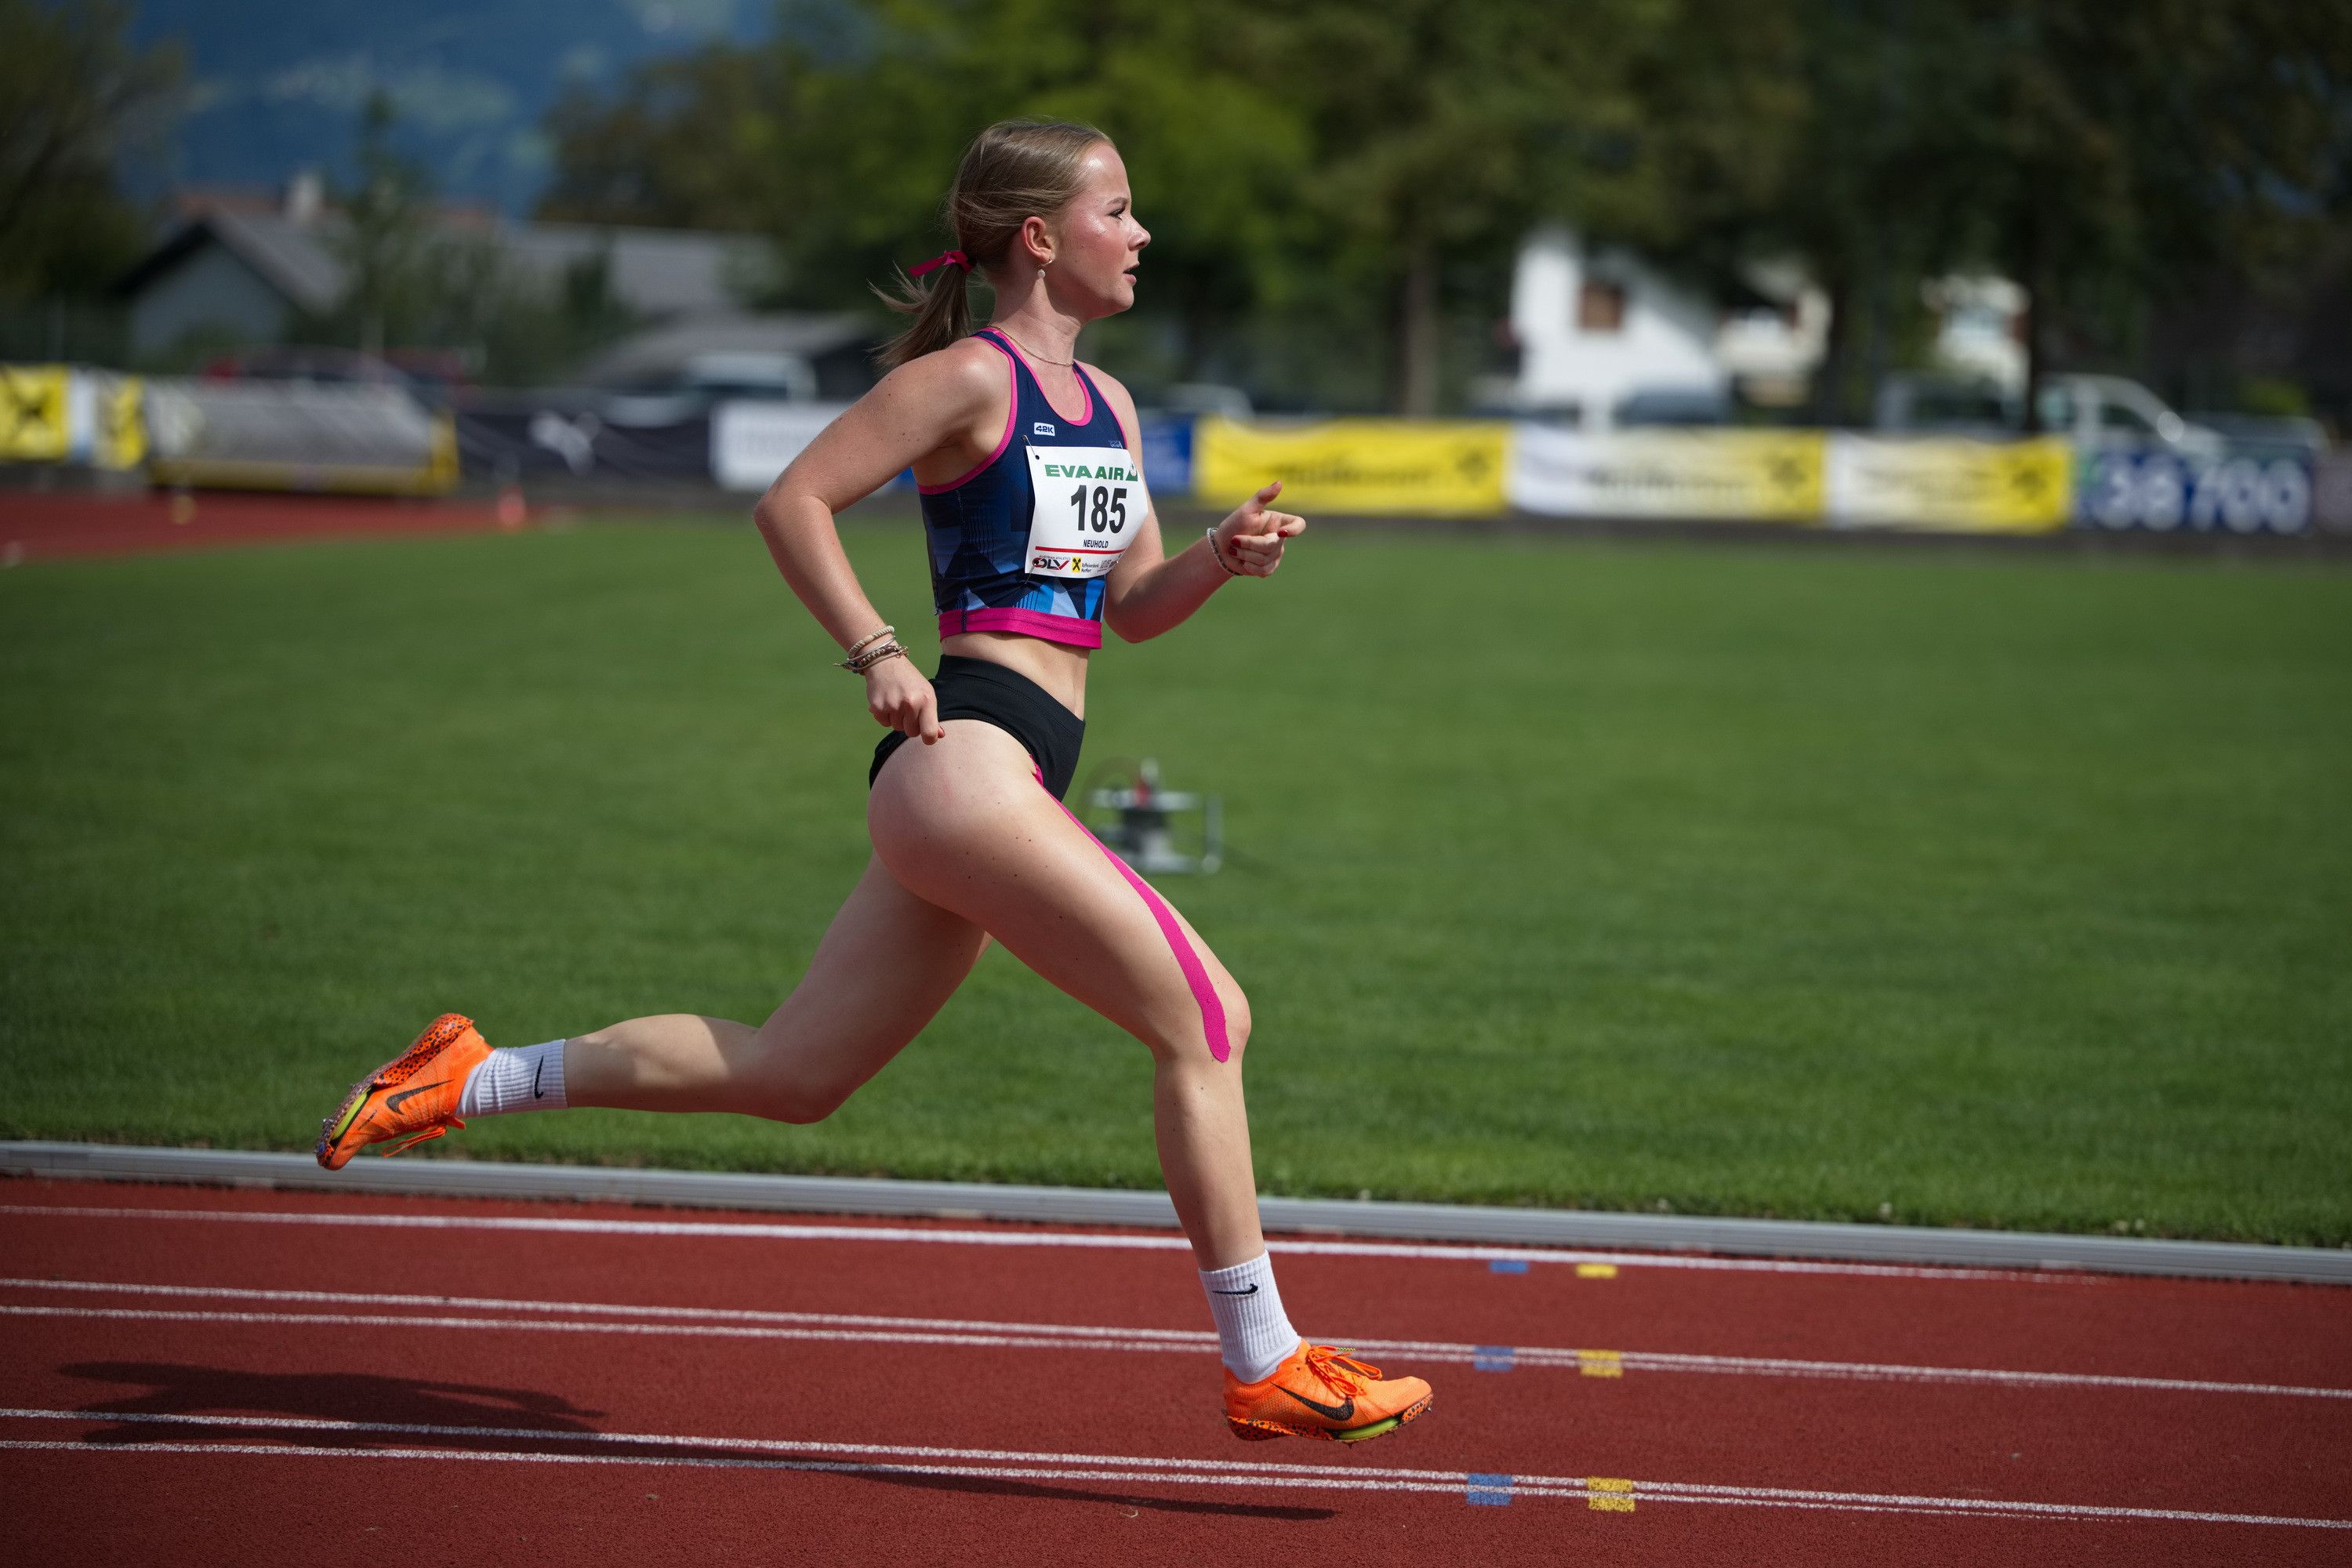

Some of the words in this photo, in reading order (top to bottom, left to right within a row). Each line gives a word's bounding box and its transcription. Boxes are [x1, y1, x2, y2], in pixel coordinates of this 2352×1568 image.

[1035, 425, 1054, 434] 42K
[1044, 464, 1093, 479] EVA
[1094, 466, 1124, 481] AIR
[1070, 485, 1127, 534] 185
[1083, 539, 1109, 549] NEUHOLD
